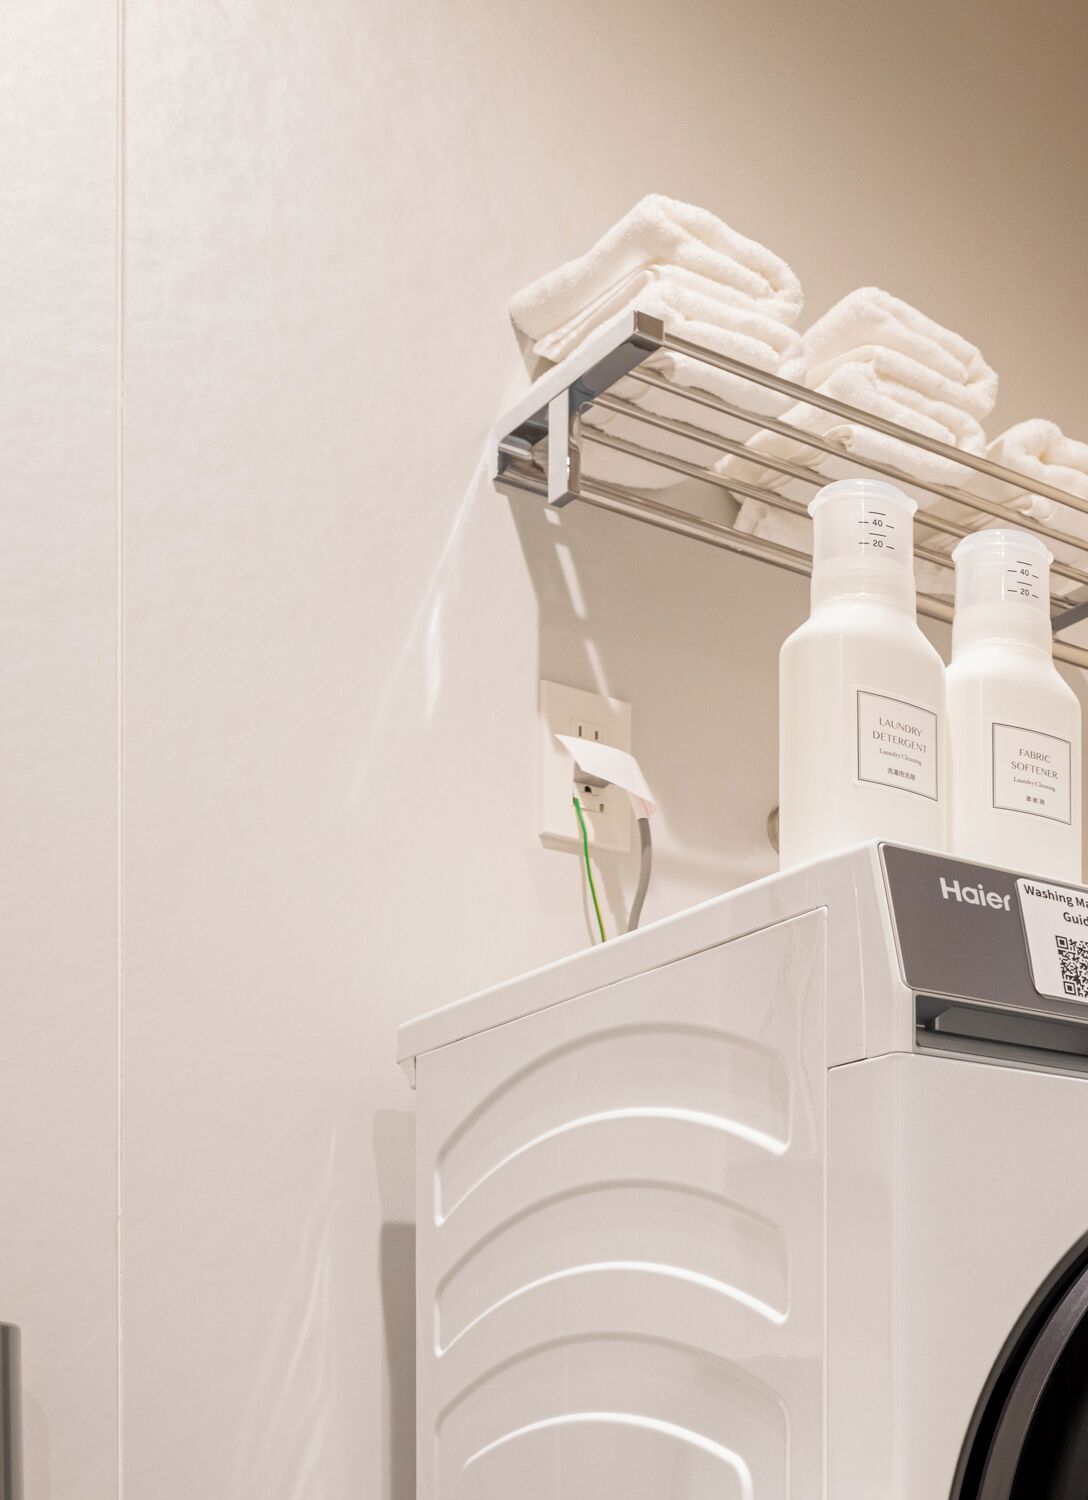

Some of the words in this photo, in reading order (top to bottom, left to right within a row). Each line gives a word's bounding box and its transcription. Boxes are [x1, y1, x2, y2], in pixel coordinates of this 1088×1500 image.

[872, 519, 883, 527] 40
[872, 539, 884, 548] 20
[1020, 568, 1030, 577] 40
[1020, 587, 1030, 596] 20
[879, 717, 922, 737] LAUNDRY
[872, 730, 928, 753] DETERGENT
[1019, 748, 1052, 763] FABRIC
[1010, 761, 1058, 780] SOFTENER
[939, 876, 1011, 912] Haier
[1023, 884, 1074, 907] Washing
